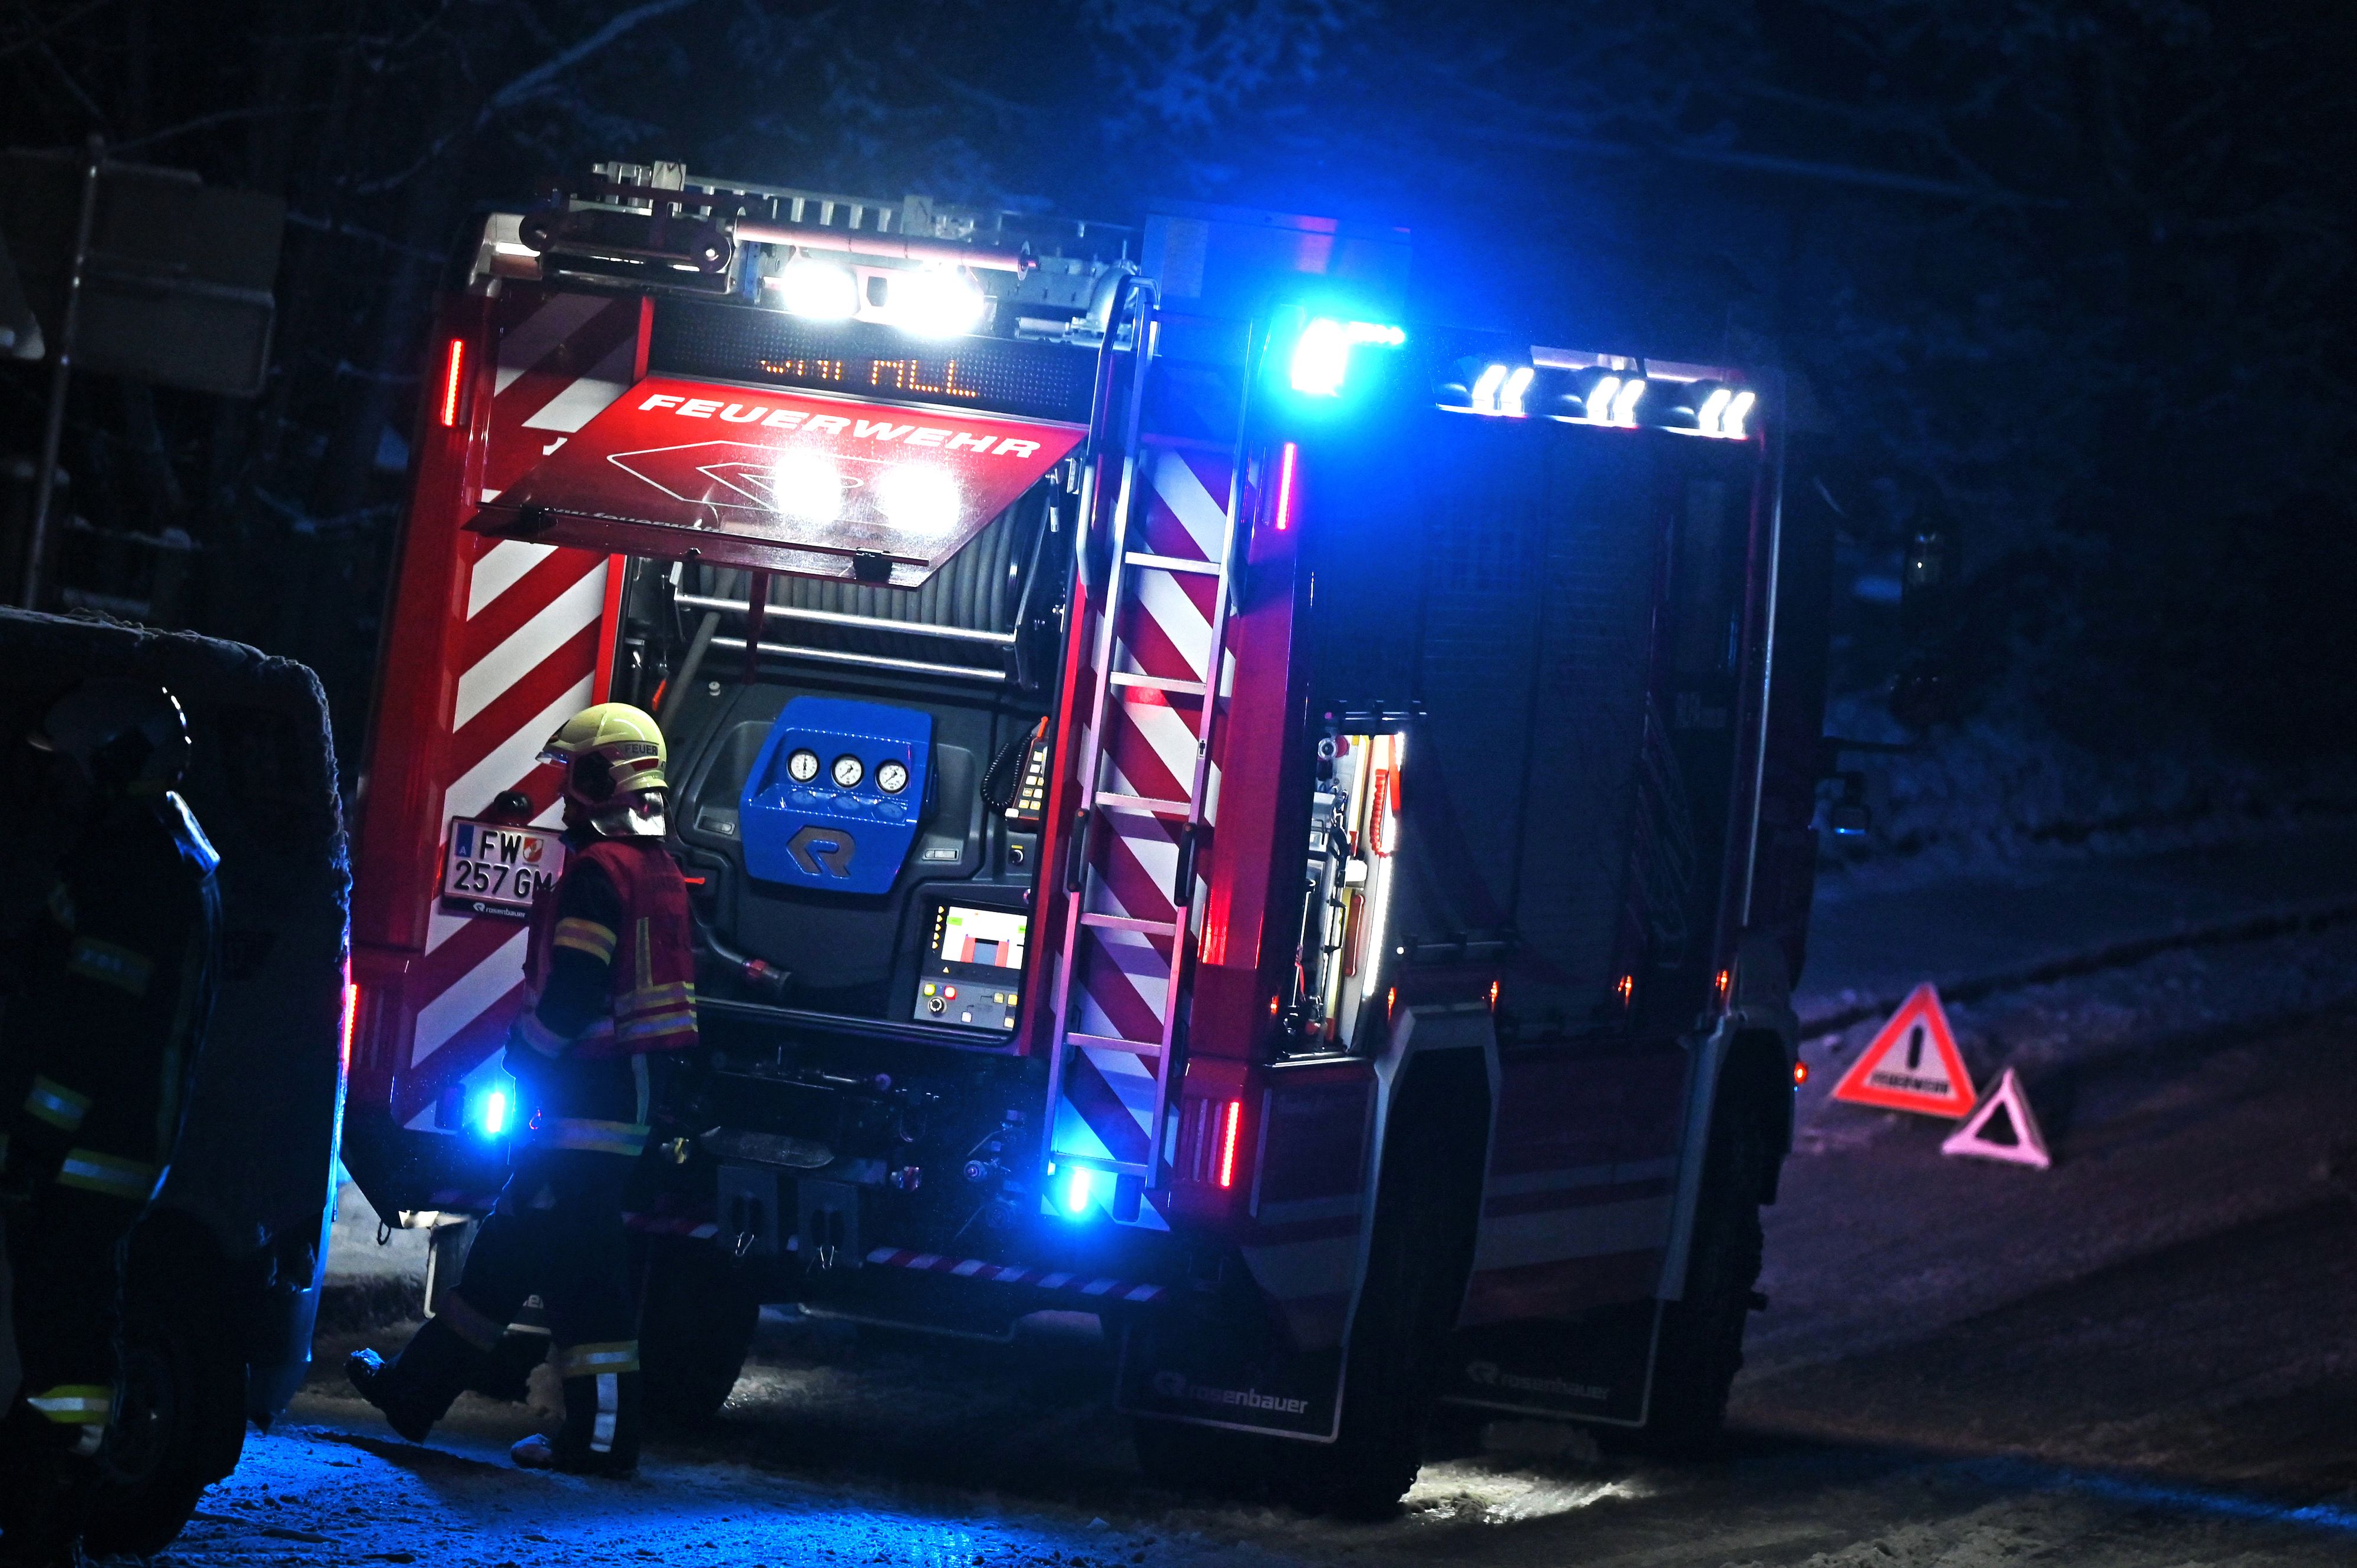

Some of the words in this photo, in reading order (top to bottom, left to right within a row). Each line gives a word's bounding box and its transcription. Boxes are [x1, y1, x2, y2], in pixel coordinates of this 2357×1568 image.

[638, 394, 1041, 458] FEUERWEHR
[480, 831, 521, 864] FW
[454, 860, 510, 894] 257
[486, 906, 526, 917] rosenbauer
